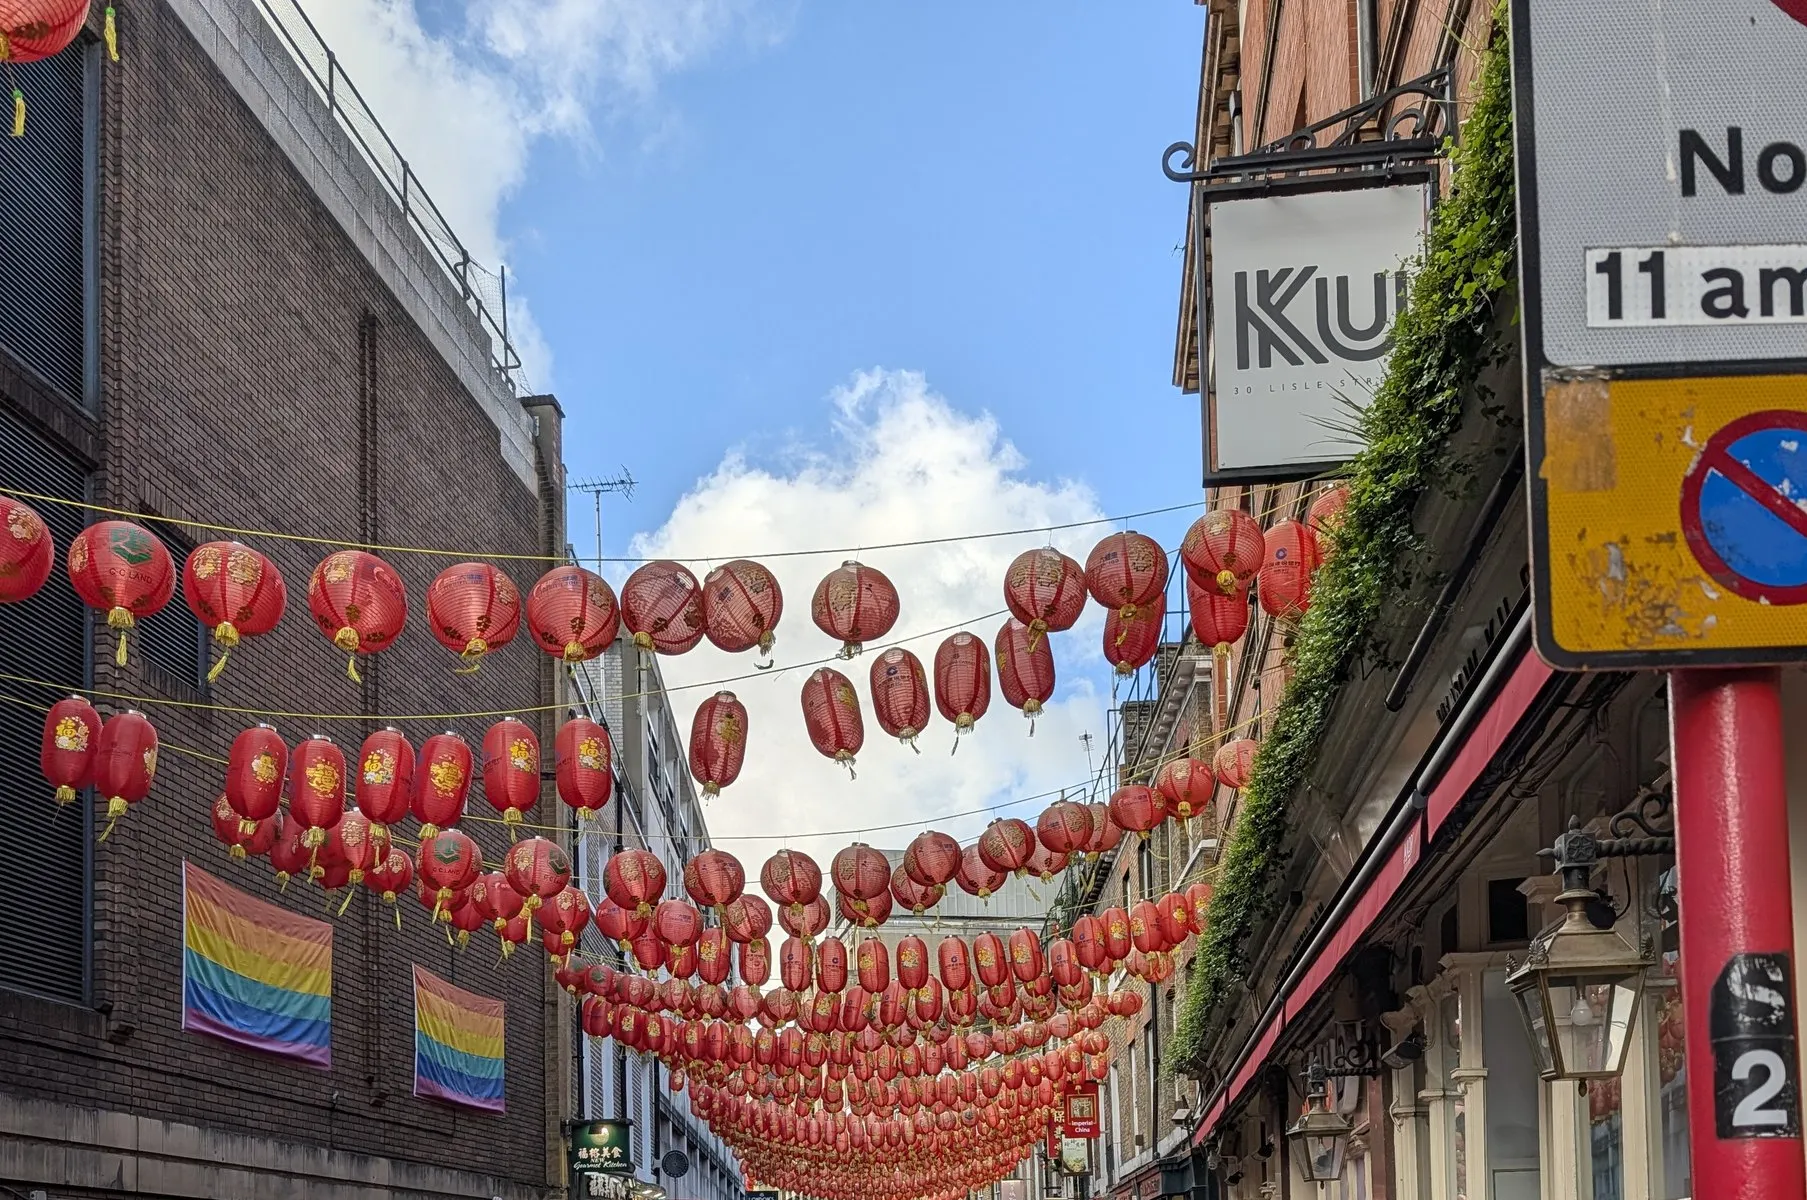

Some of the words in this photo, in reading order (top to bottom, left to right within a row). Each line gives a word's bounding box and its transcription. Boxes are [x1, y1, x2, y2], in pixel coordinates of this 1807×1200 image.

[1679, 127, 1807, 197] No
[1235, 265, 1408, 370] KU
[1596, 251, 1666, 320] 11
[1701, 266, 1807, 319] am
[1234, 386, 1252, 395] 30
[1269, 381, 1323, 393] LISLE
[1731, 1049, 1788, 1127] 2
[603, 1160, 627, 1168] Kitchen
